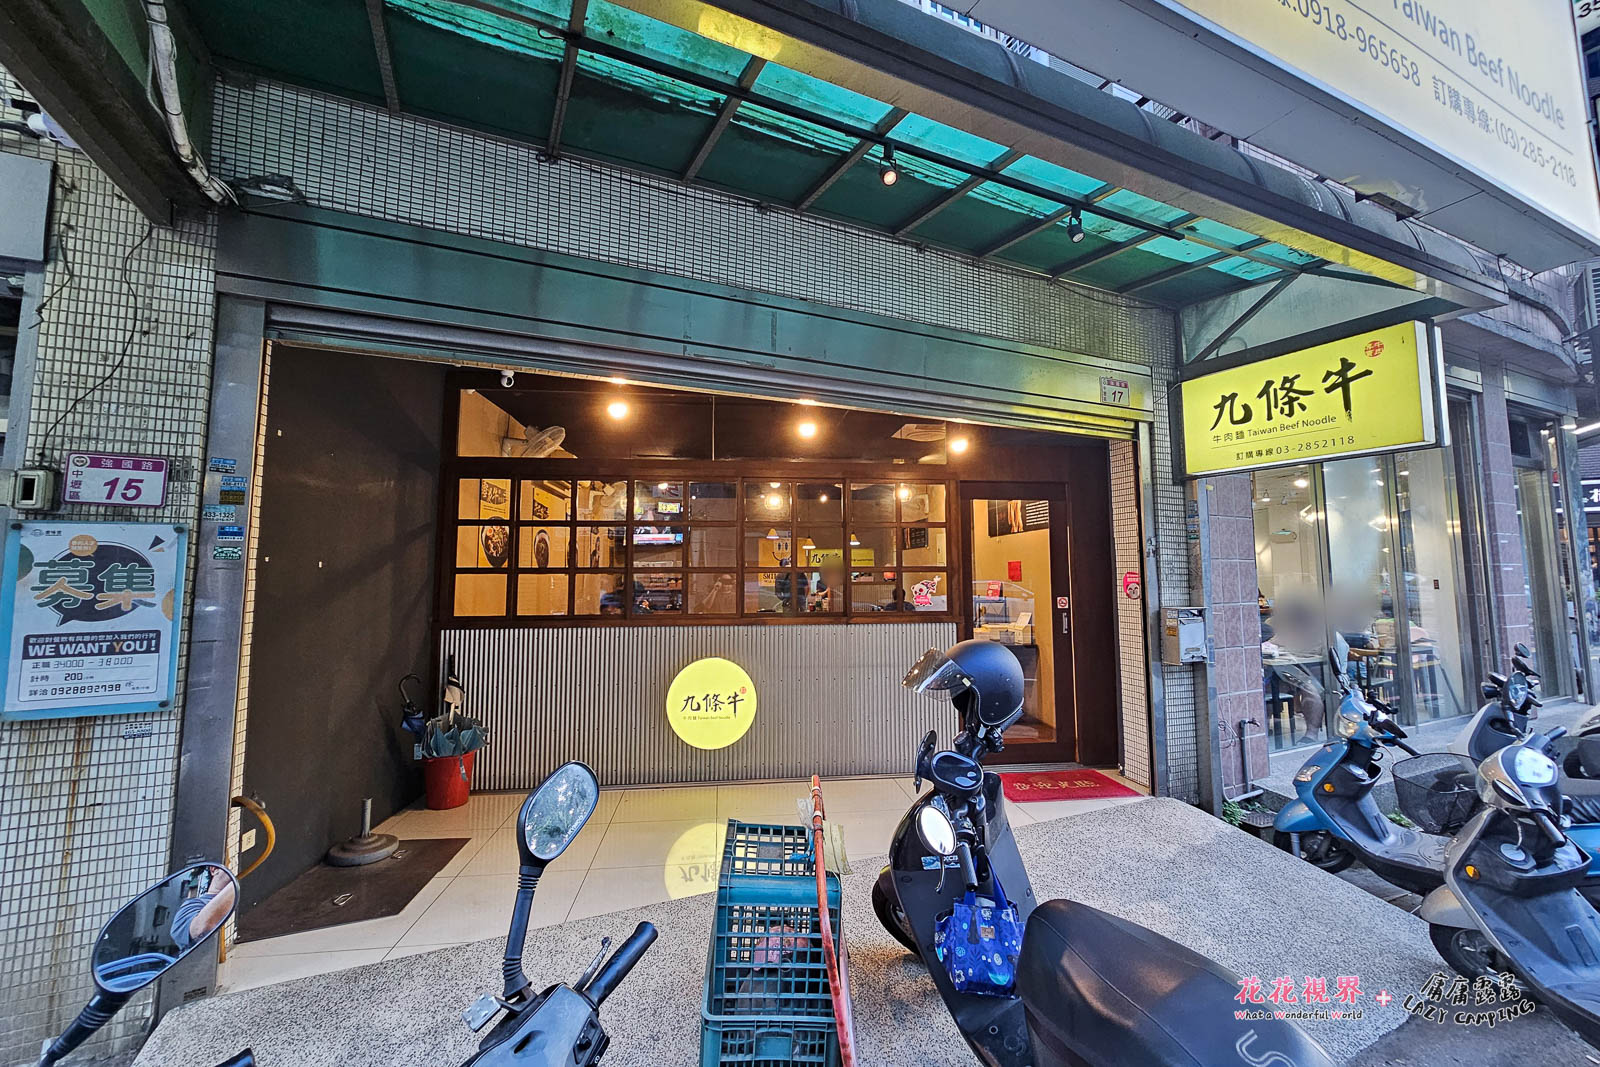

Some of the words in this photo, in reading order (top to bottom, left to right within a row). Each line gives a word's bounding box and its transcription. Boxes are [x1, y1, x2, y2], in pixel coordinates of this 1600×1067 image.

[1393, 0, 1461, 56] aiwan
[1465, 32, 1504, 88] Beef
[1507, 65, 1565, 130] Noodle
[1111, 390, 1124, 402] 17
[1209, 357, 1373, 431] 九條牛
[1212, 430, 1245, 443] 牛肉麵
[1247, 425, 1278, 438] Taiwan
[1279, 422, 1300, 432] Beef
[1302, 415, 1337, 428] Noodle
[101, 458, 153, 470] 強國路
[102, 477, 144, 501] 15
[28, 644, 56, 656] WE
[59, 642, 111, 655] WANT
[64, 672, 83, 681] 200
[680, 691, 745, 718] 九條牛
